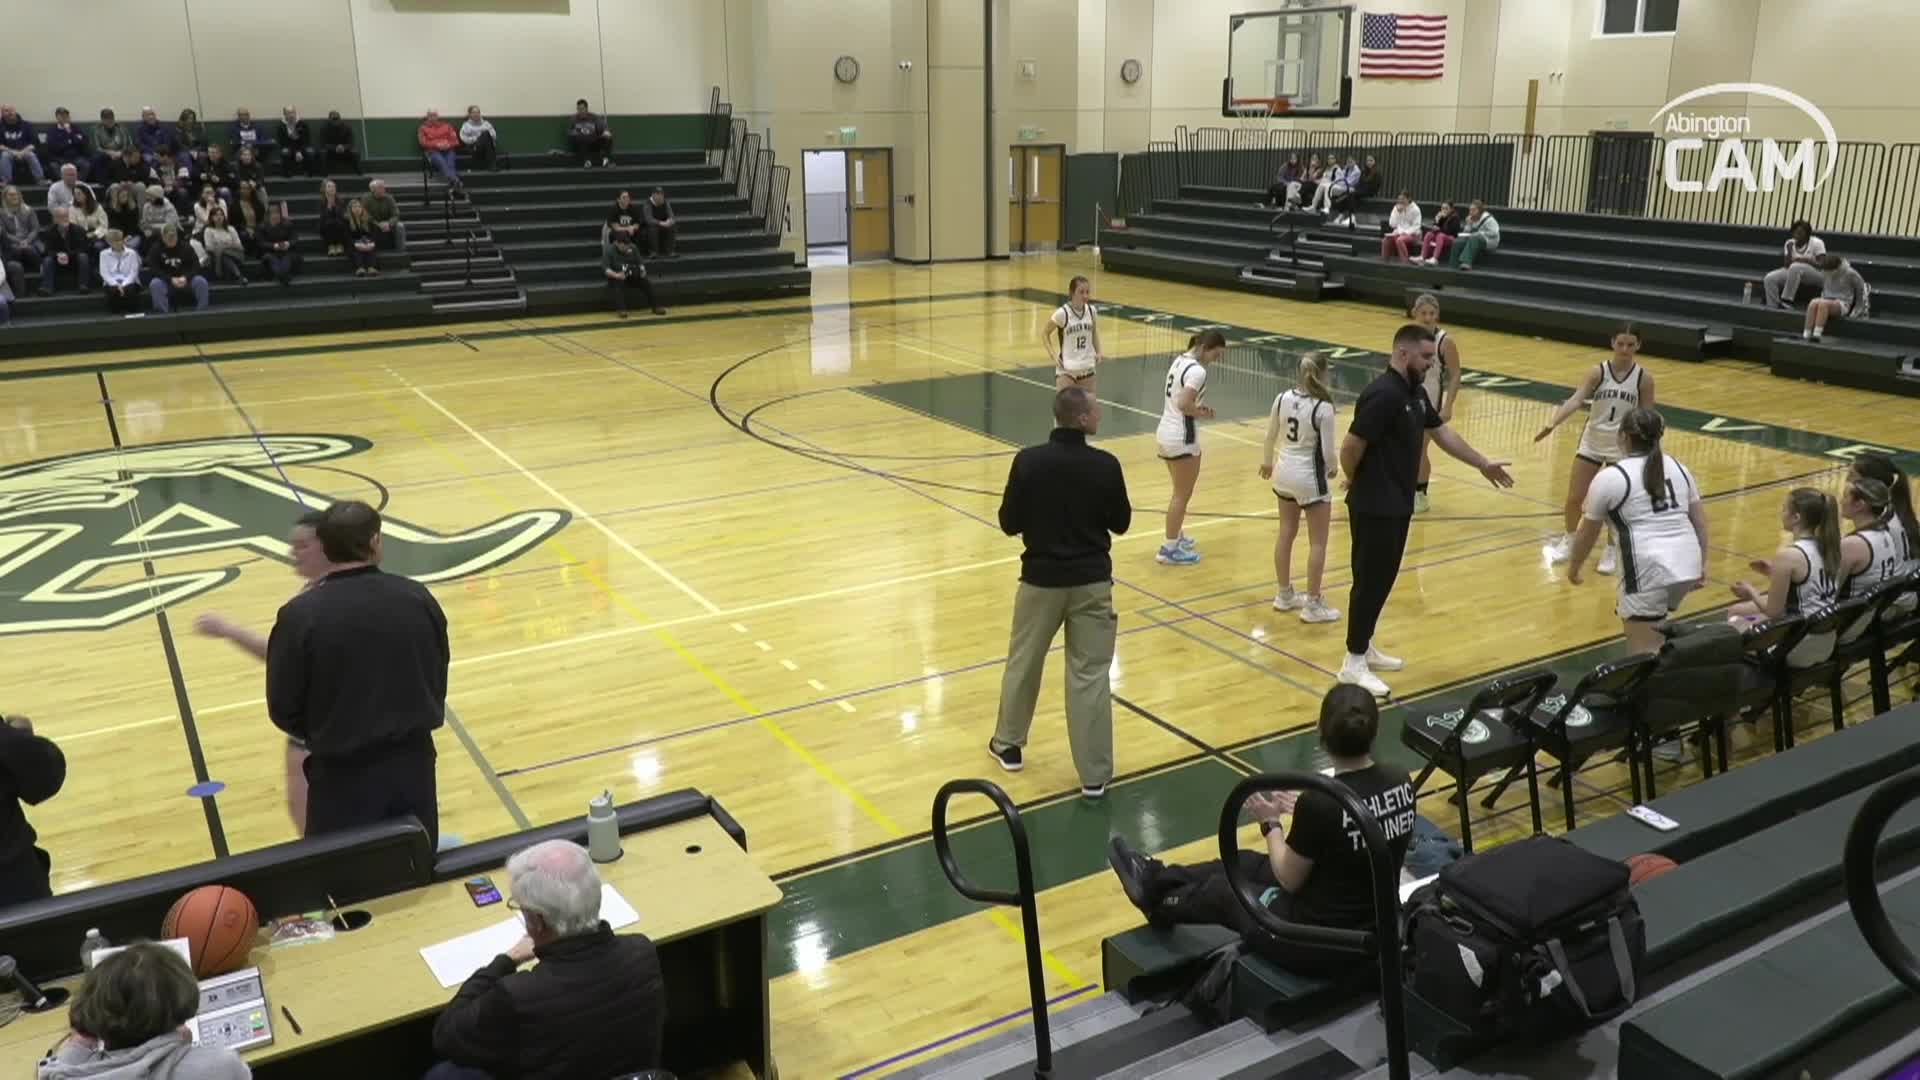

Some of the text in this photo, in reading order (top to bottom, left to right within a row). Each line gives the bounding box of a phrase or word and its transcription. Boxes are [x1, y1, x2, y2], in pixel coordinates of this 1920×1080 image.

[1076, 336, 1087, 350] 12
[1166, 373, 1175, 398] 2
[1609, 407, 1616, 422] 1
[1287, 417, 1299, 442] 3
[1342, 782, 1415, 828] AHLETIC
[1347, 809, 1415, 851] TINER
